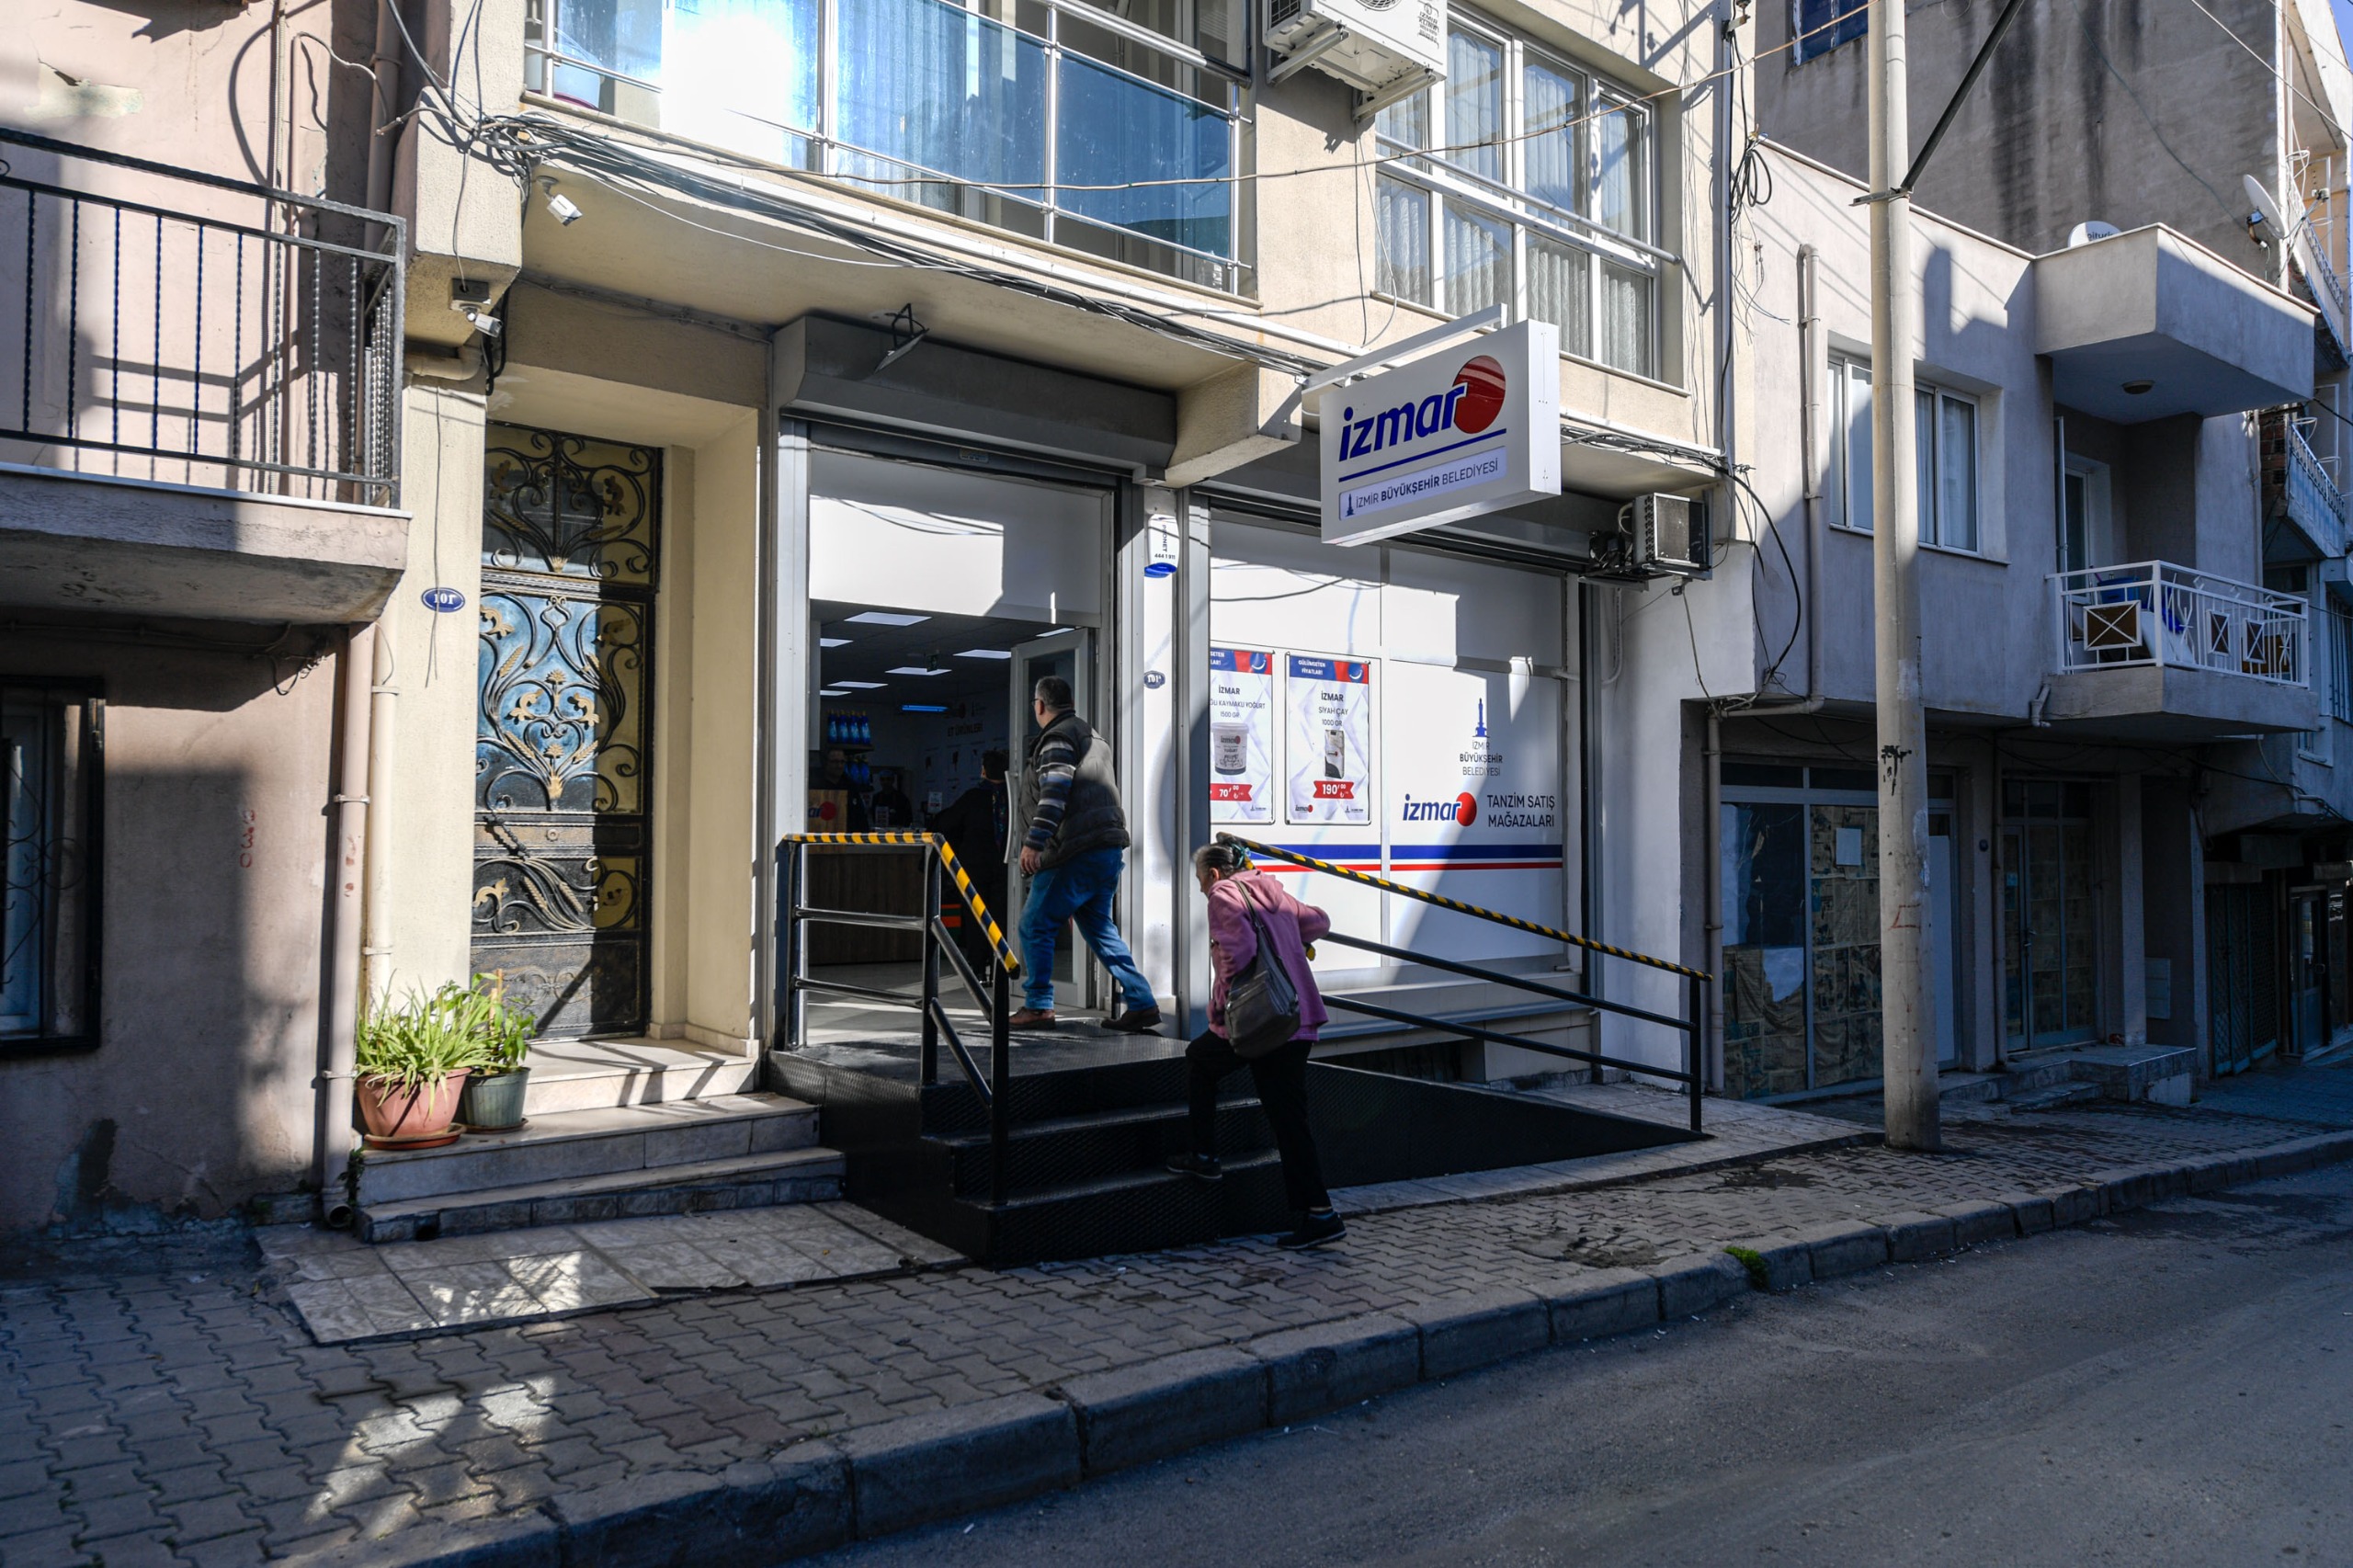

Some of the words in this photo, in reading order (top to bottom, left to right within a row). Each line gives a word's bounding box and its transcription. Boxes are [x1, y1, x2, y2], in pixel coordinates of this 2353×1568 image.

[1338, 385, 1466, 461] izmar
[1356, 493, 1380, 509] İZMİR
[1381, 474, 1440, 500] BÜYÜKŞEHİR
[1442, 458, 1498, 485] BELEDİYESİ
[1298, 659, 1326, 668] GÜLÜMSETEN
[1218, 684, 1241, 695] İZMAR
[1321, 690, 1344, 702] İZMAR
[1245, 701, 1266, 710] YOĞURT
[1318, 706, 1336, 714] SİYAH
[1336, 708, 1349, 718] ÇAY
[1472, 740, 1491, 750] İZMİR
[1460, 753, 1503, 765] BÜYÜKŞEHİR
[1462, 766, 1501, 777] BELEDİYESİ
[1402, 793, 1461, 822] izmar
[1487, 791, 1525, 809] TANZİM
[1528, 795, 1555, 812] SATIŞ
[1487, 811, 1555, 828] MAĞAZALARI
